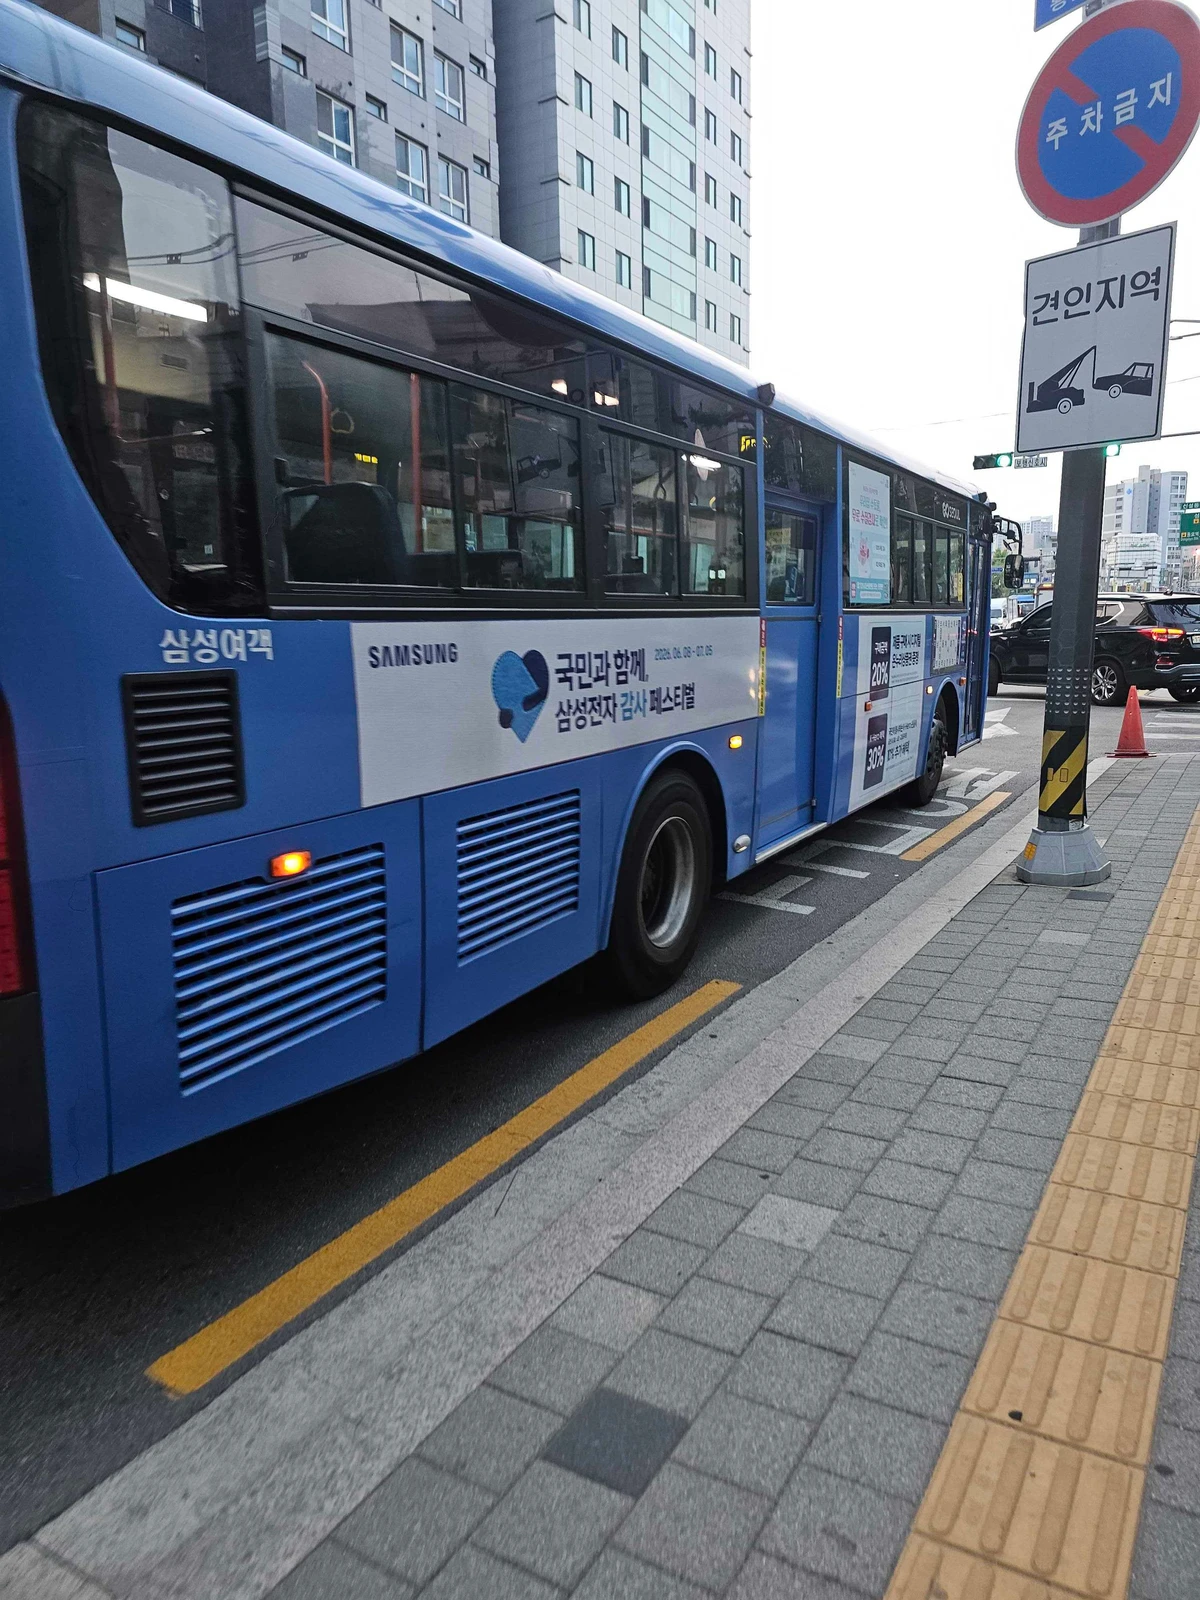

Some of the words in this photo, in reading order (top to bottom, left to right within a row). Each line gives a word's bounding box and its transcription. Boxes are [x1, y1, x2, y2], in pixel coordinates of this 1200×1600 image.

[1045, 72, 1173, 151] 주차금지
[1032, 266, 1161, 326] 견인지역
[158, 629, 275, 664] 삼성여객
[368, 642, 459, 668] SAMSUNG
[555, 650, 611, 691] 국민과
[871, 661, 889, 687] 20%
[555, 692, 618, 733] 삼성전자
[620, 688, 647, 721] 감사
[649, 682, 695, 715] 페스티벌
[866, 744, 885, 772] 30%
